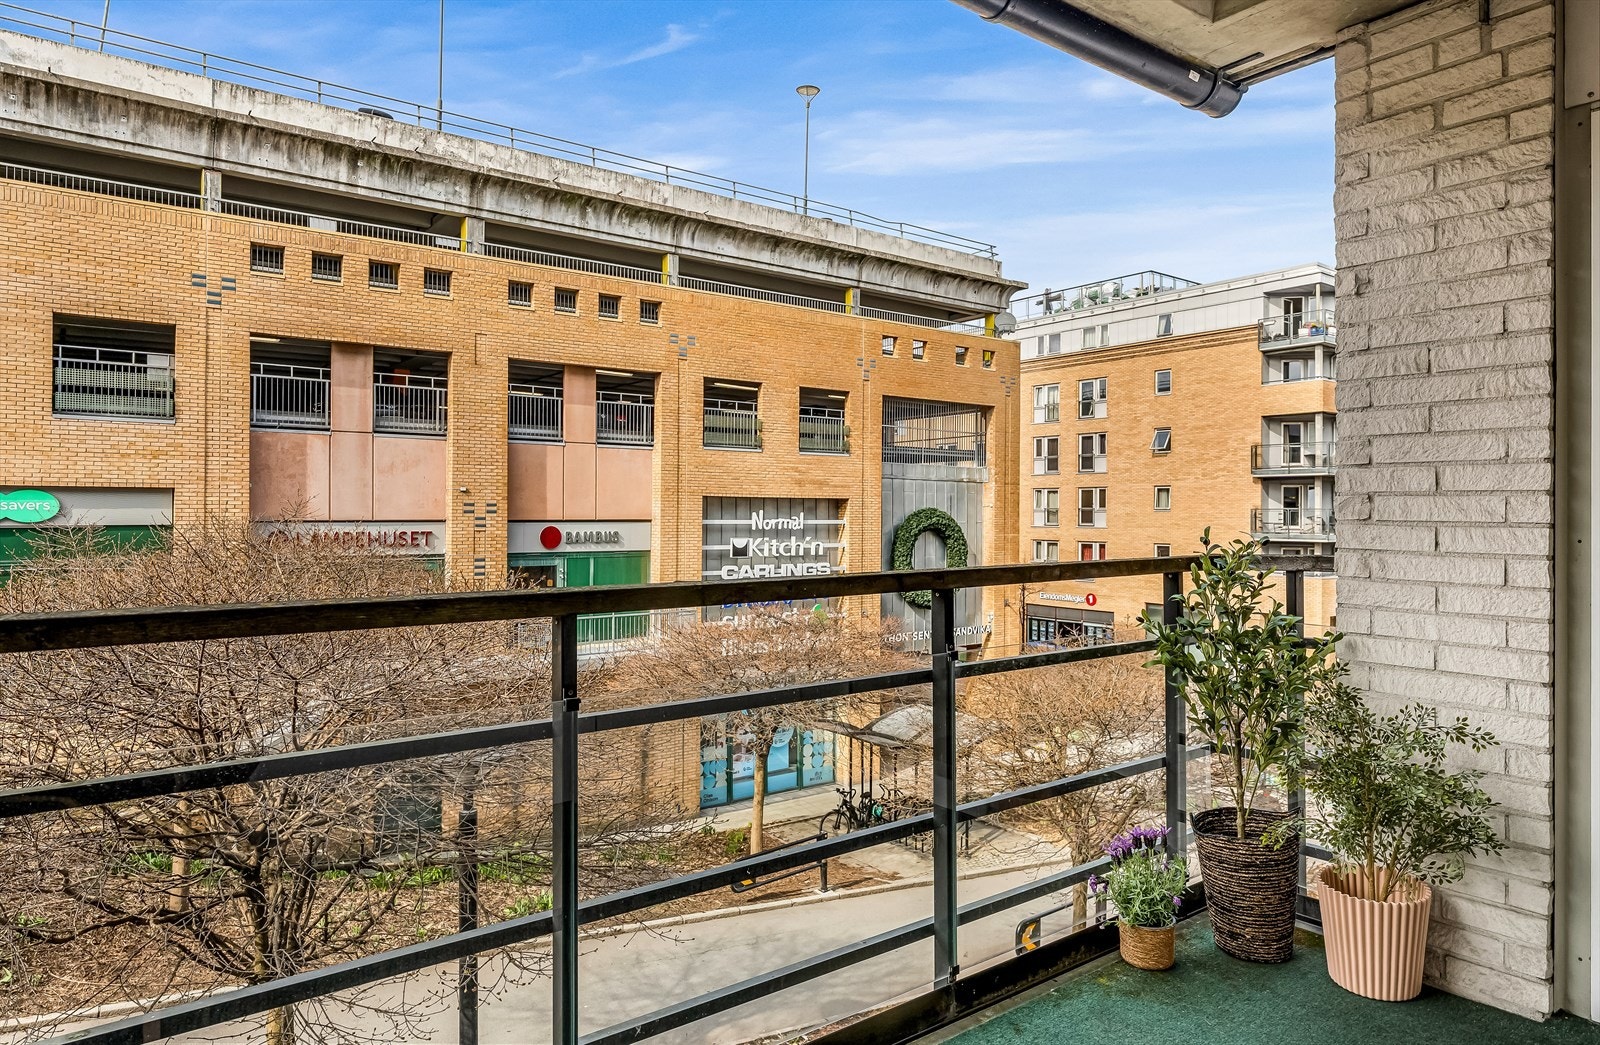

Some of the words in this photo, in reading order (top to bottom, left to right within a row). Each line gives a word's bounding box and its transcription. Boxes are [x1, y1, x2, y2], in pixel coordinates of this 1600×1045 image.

[0, 501, 50, 510] savers
[752, 510, 804, 530] Normal
[565, 531, 620, 545] BAMBUS
[721, 562, 831, 580] CARLINGS
